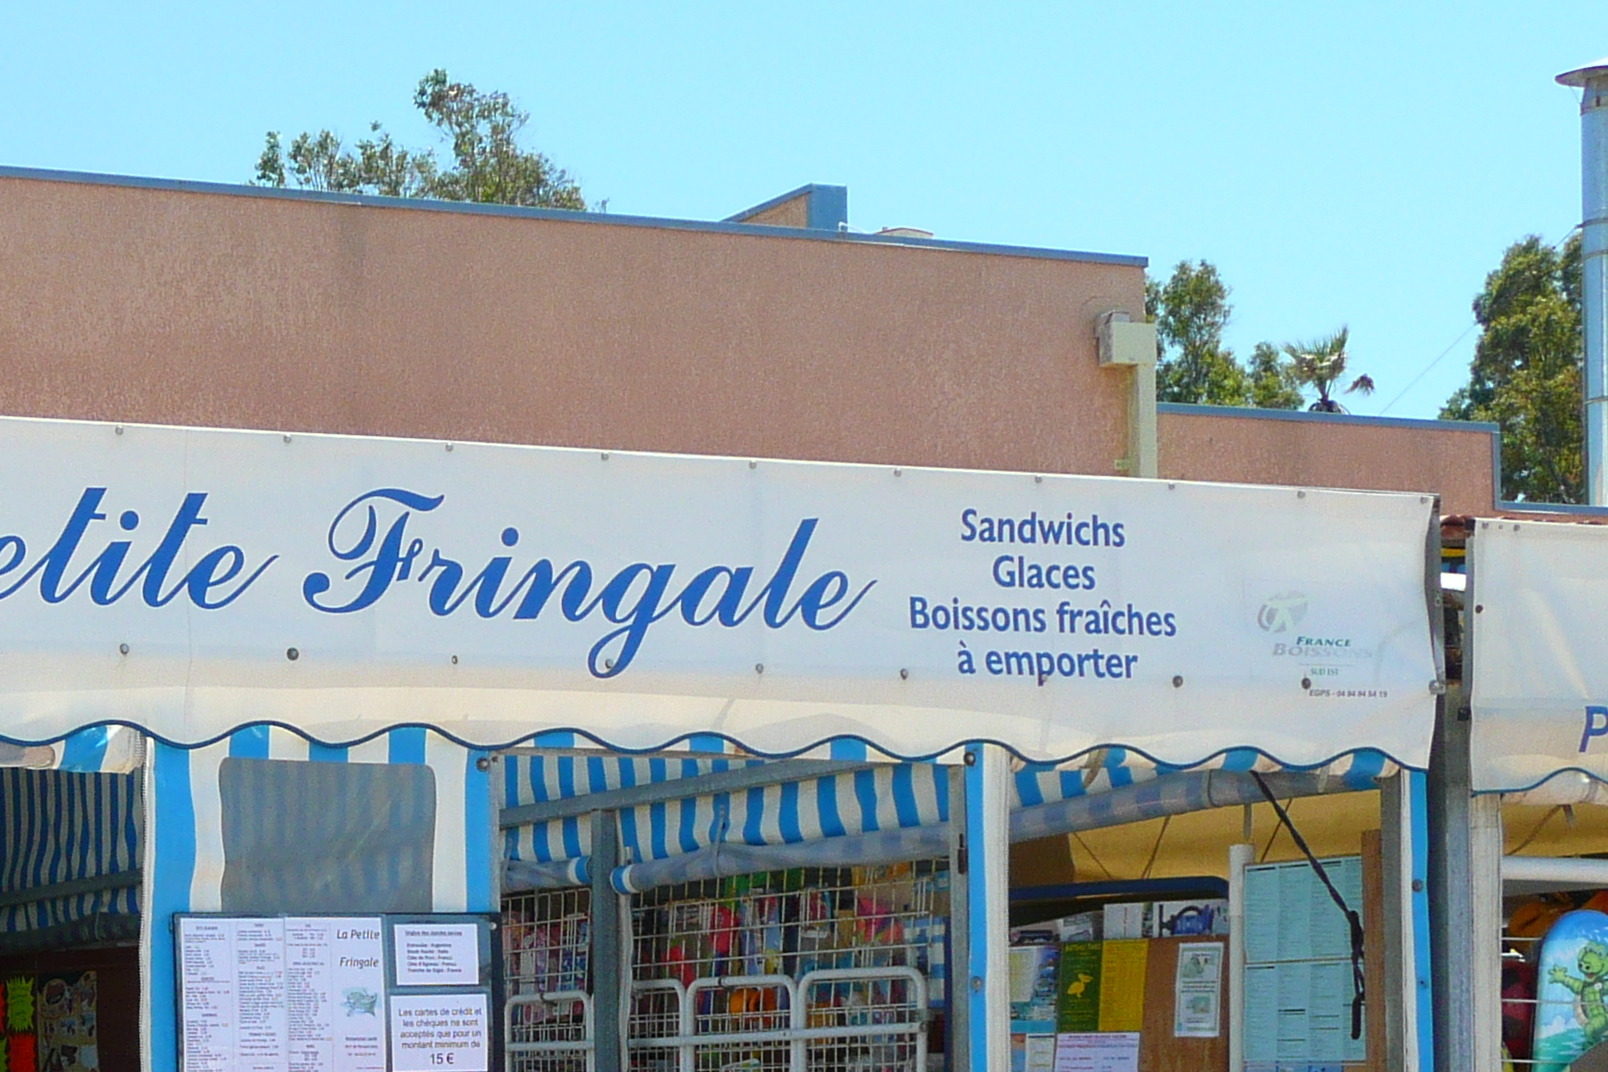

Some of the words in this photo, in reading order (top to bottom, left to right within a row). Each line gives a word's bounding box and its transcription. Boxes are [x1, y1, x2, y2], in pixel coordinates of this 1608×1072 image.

[960, 509, 1126, 549] Sandwichs
[992, 556, 1096, 590] Glaces
[303, 488, 878, 679] Fringale
[909, 596, 1048, 635] Boissons
[1056, 600, 1177, 638] fraîches
[1296, 636, 1352, 647] FRANCE
[1272, 643, 1374, 659] BOISSONS
[957, 642, 977, 676] à
[985, 649, 1139, 686] emporter
[336, 929, 348, 940] La
[340, 957, 379, 969] Fringale
[398, 1008, 412, 1016] Les
[415, 1008, 438, 1016] cartes
[440, 1007, 450, 1015] de
[452, 1007, 472, 1016] crédit
[403, 1019, 414, 1027] les
[462, 1018, 478, 1026] sont
[400, 1029, 434, 1039] acceptés
[436, 1031, 450, 1040] que
[453, 1031, 470, 1039] pour
[401, 1040, 433, 1049] montant
[429, 1053, 444, 1064] 15
[446, 1053, 455, 1064] €
